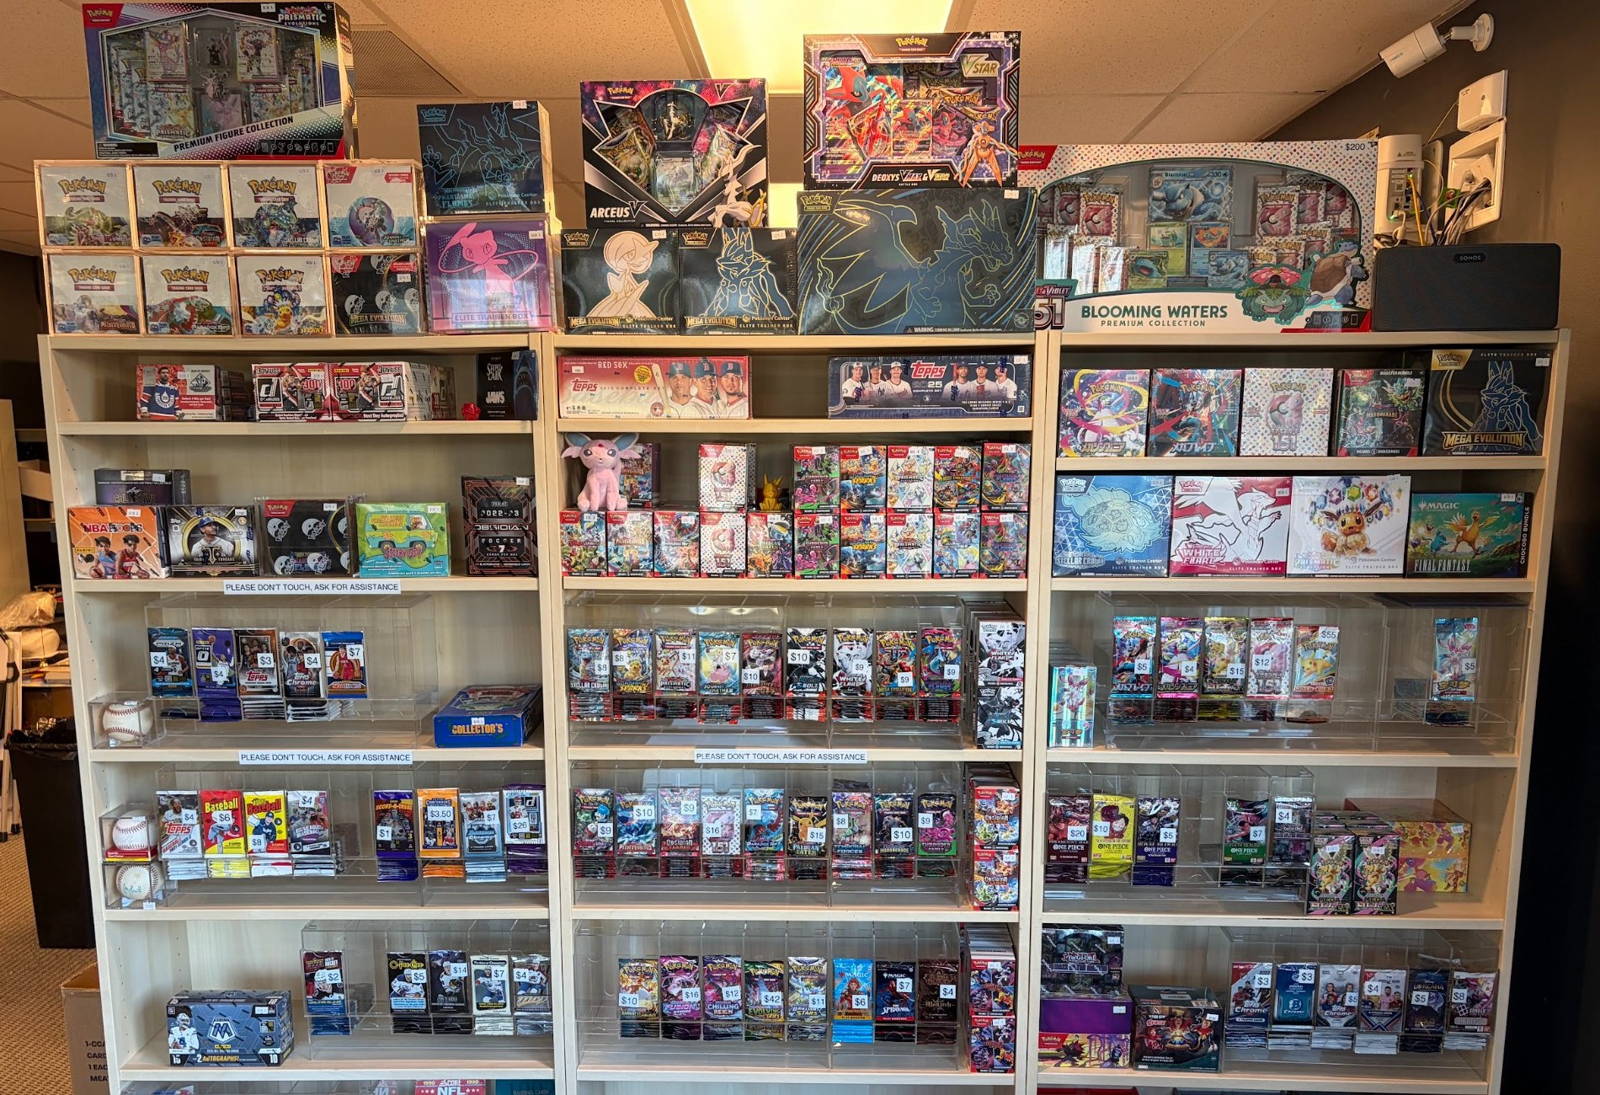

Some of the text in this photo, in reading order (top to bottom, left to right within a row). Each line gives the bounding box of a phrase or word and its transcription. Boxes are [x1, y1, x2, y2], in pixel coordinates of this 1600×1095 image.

[277, 13, 327, 23] PRISMATIC
[173, 134, 214, 153] PREMIUM
[214, 127, 245, 142] FIGURE
[245, 116, 294, 134] COLLECTION
[1345, 142, 1366, 151] $200
[872, 173, 900, 182] DEOXYS
[589, 206, 630, 218] ARCEUS
[1080, 304, 1229, 319] BLOOMING WATERS
[1100, 320, 1206, 328] PREMIUM COLLECTION
[598, 360, 628, 370] RED SOX
[1446, 433, 1524, 446] MEGA EVOLUTION
[1426, 502, 1460, 510] MAGIC
[1522, 506, 1530, 532] BUNDLE
[84, 522, 107, 534] NBA
[1182, 548, 1221, 559] WHITE
[1438, 559, 1472, 572] FANTASY
[225, 582, 399, 592] PLEASE DON'T TOUCH, ASK FOR ASSISTANCE
[1320, 630, 1337, 640] $55
[350, 648, 362, 658] $7
[682, 652, 696, 662] $11
[724, 651, 736, 660] $7
[790, 653, 808, 662] $10
[152, 656, 166, 666] $4
[260, 656, 272, 665] $3
[306, 656, 319, 666] $4
[1254, 658, 1270, 667] $12
[854, 662, 864, 672] $9
[1137, 662, 1148, 672] $5
[1184, 665, 1195, 674] $4
[1229, 667, 1245, 676] $15
[1464, 662, 1476, 672] $5
[214, 669, 224, 678] $4
[742, 672, 758, 681] $10
[946, 668, 956, 676] $9
[900, 676, 910, 684] $9
[452, 723, 504, 734] COLLECTOR'S
[240, 754, 410, 763] PLEASE DON'T TOUCH, ASK FOR ASSISTANCE
[696, 752, 866, 761] PLEASE DON'T TOUCH, ASK FOR ASSISTANCE
[301, 795, 313, 806] $4
[204, 800, 239, 812] Baseball
[246, 800, 282, 814] Baseball
[682, 803, 694, 812] $9
[430, 810, 452, 818] $3.50
[635, 808, 652, 817] $10
[748, 808, 758, 816] $7
[1278, 812, 1290, 820] $4
[184, 812, 194, 822] $4
[218, 812, 231, 822] $6
[487, 814, 496, 822] $7
[836, 817, 846, 826] $8
[920, 816, 931, 825] $9
[600, 826, 612, 835] $9
[706, 826, 720, 835] $16
[1094, 824, 1108, 834] $10
[379, 830, 390, 838] $1
[809, 831, 824, 840] $15
[893, 830, 911, 840] $10
[1070, 830, 1086, 838] $20
[1163, 831, 1174, 840] $5
[1252, 830, 1262, 838] $7
[453, 966, 467, 974] $14
[494, 970, 505, 978] $7
[327, 972, 340, 982] $2
[414, 972, 424, 980] $5
[515, 972, 526, 980] $4
[1301, 972, 1313, 982] $3
[898, 981, 910, 990] $7
[1257, 976, 1269, 986] $3
[942, 988, 954, 996] $4
[1367, 984, 1380, 992] $4
[684, 990, 699, 998] $16
[725, 990, 740, 998] $12
[621, 996, 638, 1005] $10
[763, 995, 780, 1004] $42
[812, 998, 825, 1006] $11
[854, 997, 866, 1006] $6
[1414, 994, 1426, 1004] $5
[172, 1054, 181, 1064] 15
[196, 1054, 202, 1062] 2
[269, 1054, 278, 1064] 10
[437, 1086, 466, 1095] NFL
